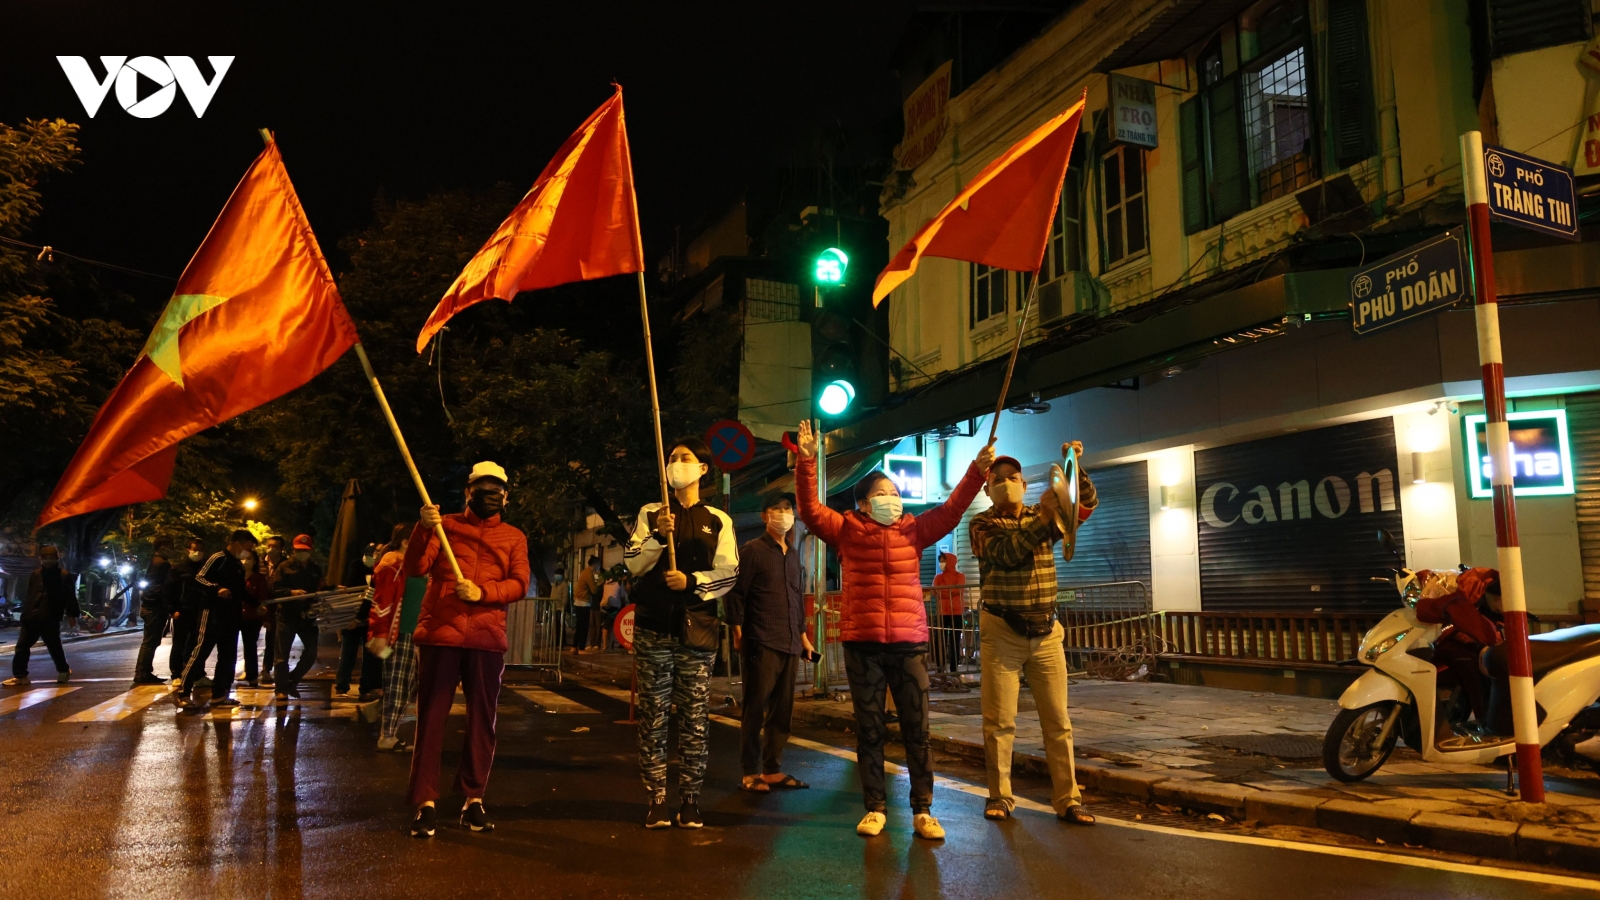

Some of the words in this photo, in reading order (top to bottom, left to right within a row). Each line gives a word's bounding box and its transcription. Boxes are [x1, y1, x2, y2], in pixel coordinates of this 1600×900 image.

[1120, 106, 1153, 130] TRỌ
[1118, 130, 1125, 138] 22
[1516, 167, 1544, 186] PHỐ
[1493, 182, 1545, 219] TRÀNG
[1547, 197, 1571, 226] THI
[1385, 255, 1419, 284] PHỐ
[1359, 283, 1396, 325] PHỦ
[1401, 269, 1457, 311] DOÃN
[1201, 468, 1396, 528] Canon
